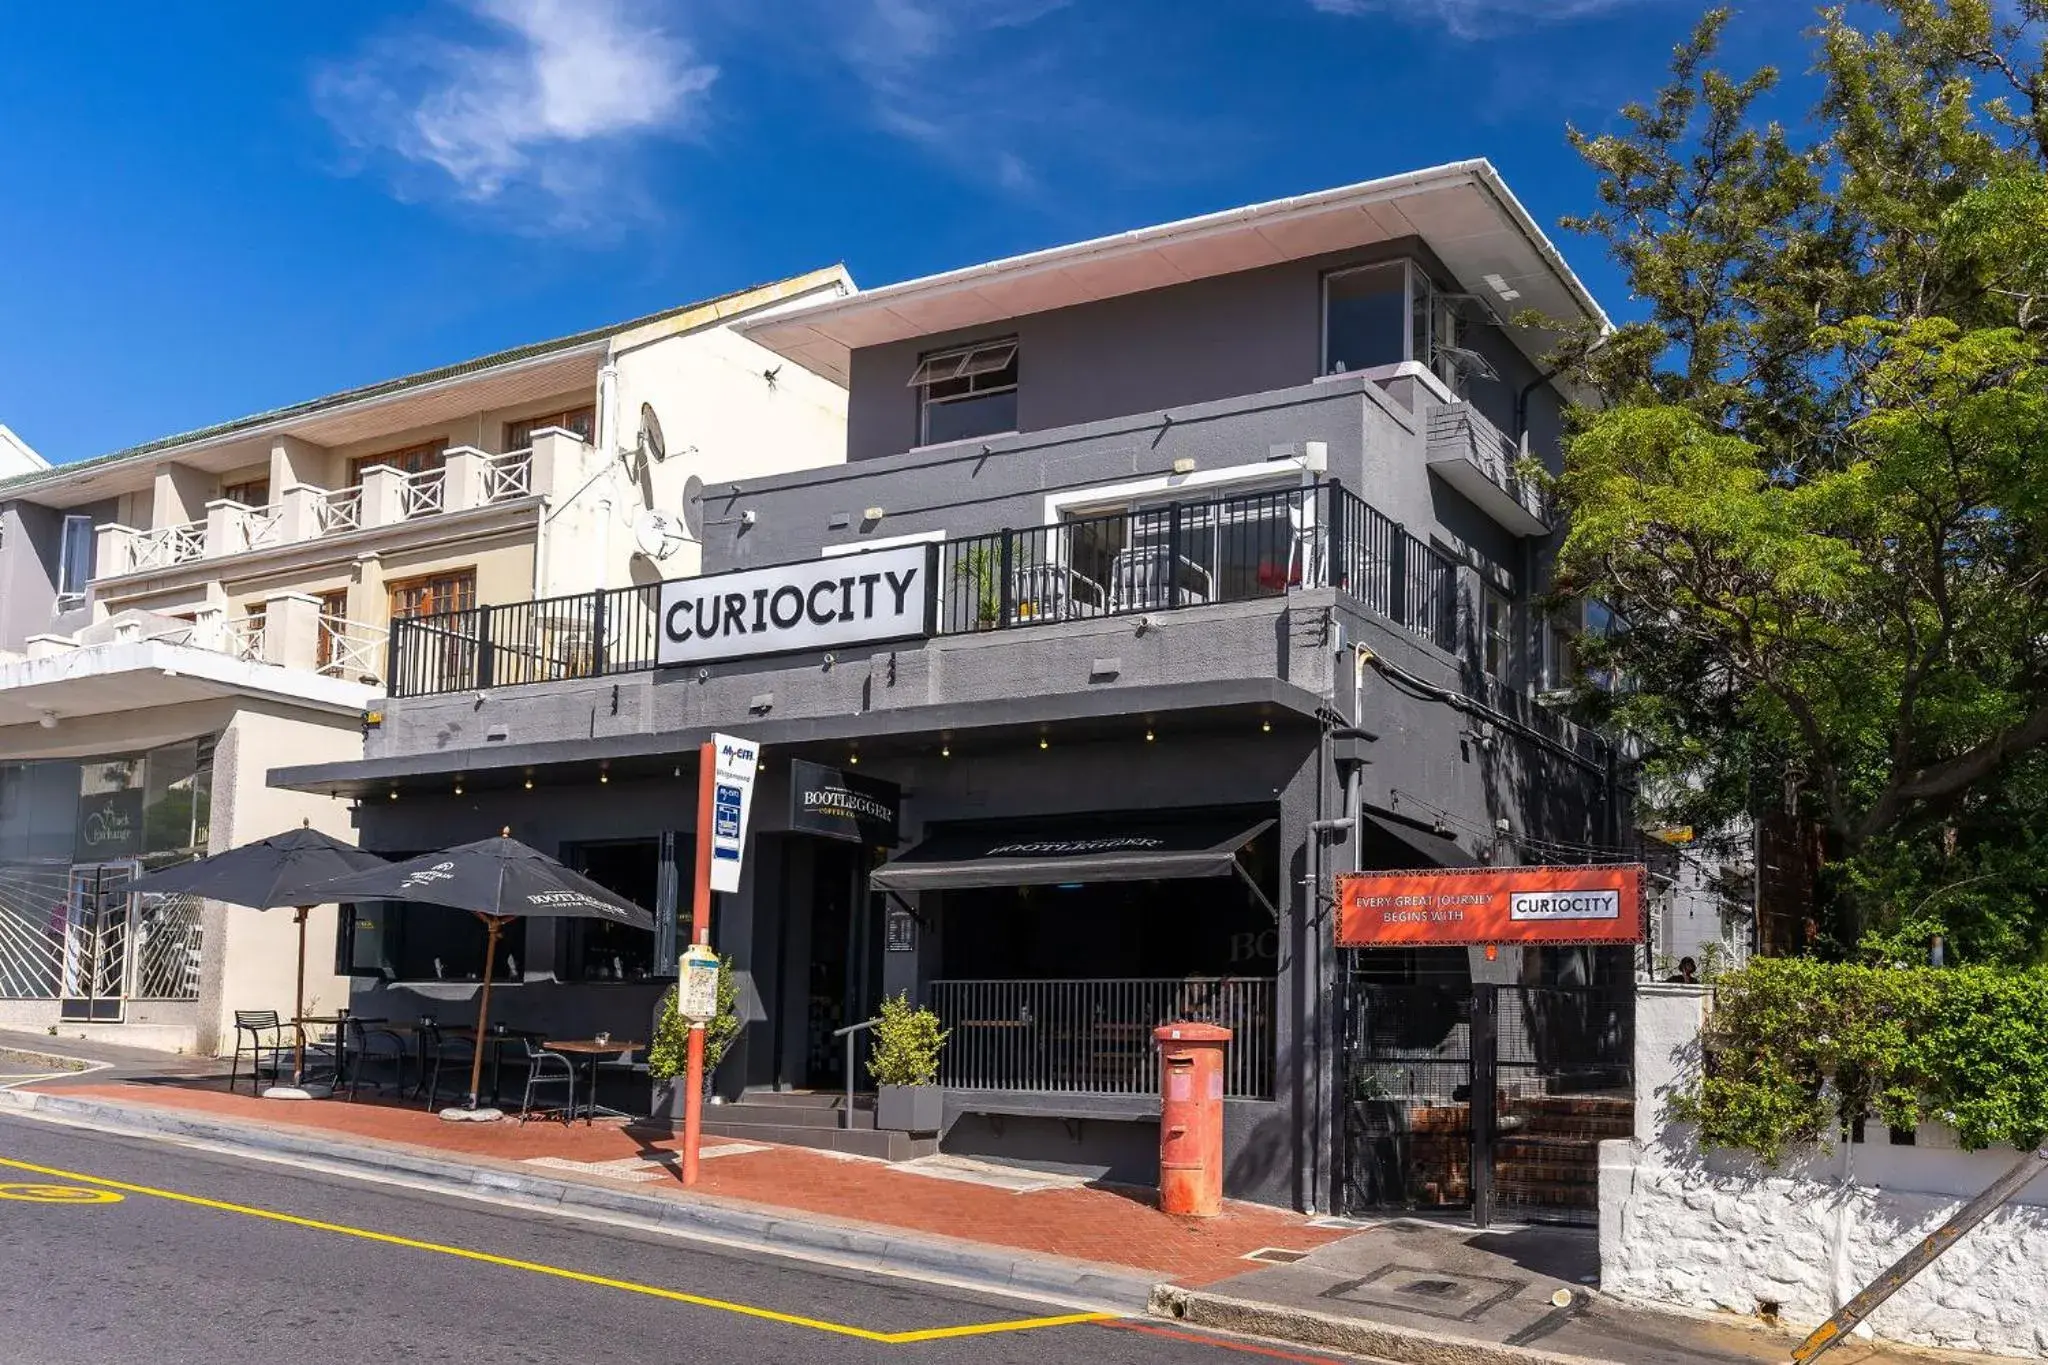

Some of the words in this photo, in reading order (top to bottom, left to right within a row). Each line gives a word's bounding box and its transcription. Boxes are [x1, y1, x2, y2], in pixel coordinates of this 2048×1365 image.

[665, 568, 918, 643] CURIOCITY
[804, 790, 893, 823] BOOTLEGGER
[1356, 895, 1392, 908] EVERY
[1394, 894, 1434, 907] GREAT
[1436, 893, 1493, 908] JOURNEY
[1516, 897, 1613, 913] CURIOCITY
[1383, 911, 1428, 923] BEGINS
[1430, 910, 1464, 921] WITH
